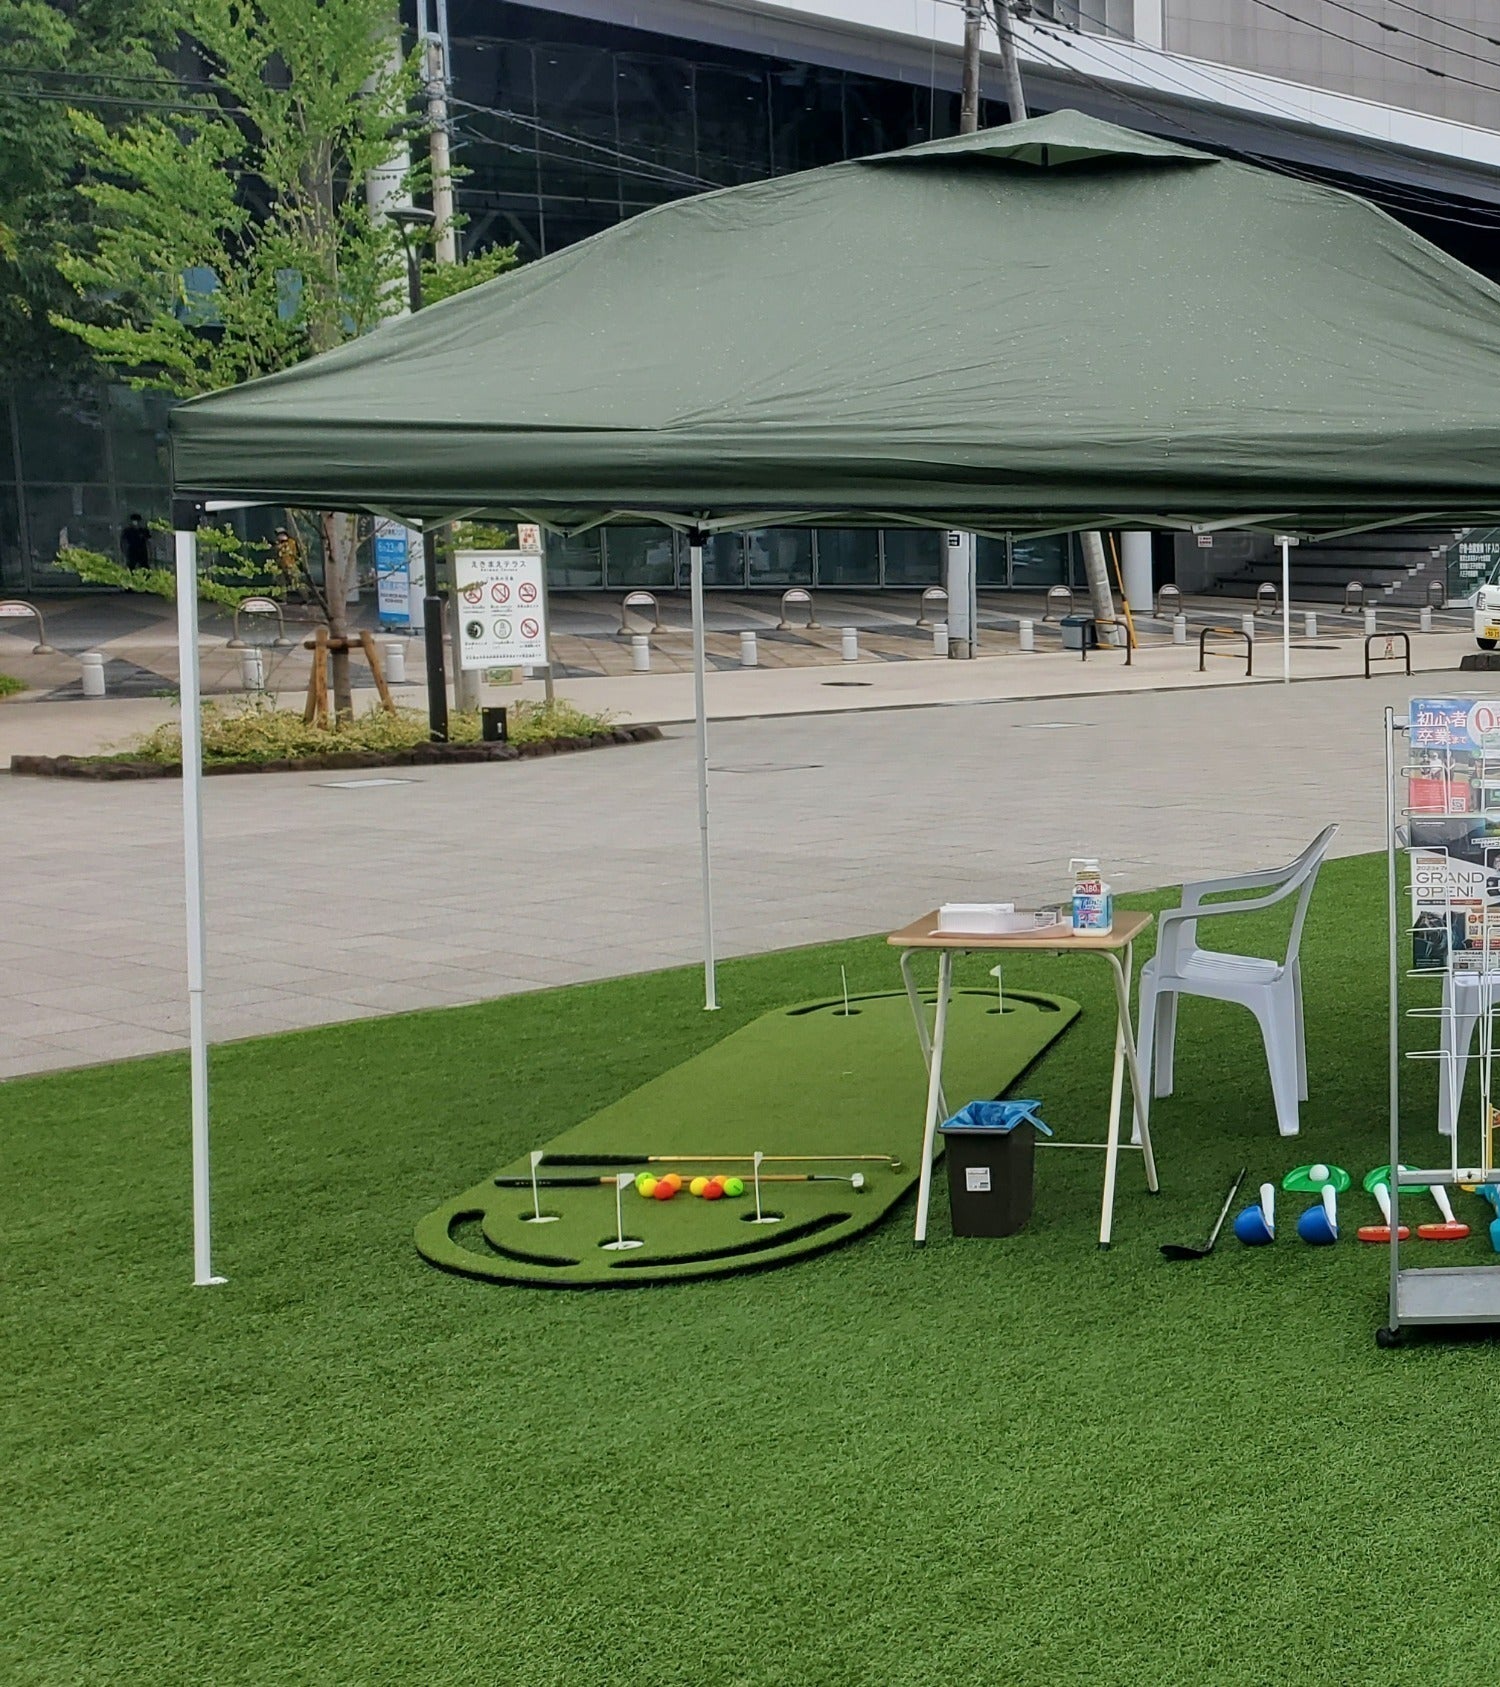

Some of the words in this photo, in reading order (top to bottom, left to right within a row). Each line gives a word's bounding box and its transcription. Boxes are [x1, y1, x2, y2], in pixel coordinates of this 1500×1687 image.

[1417, 711, 1467, 727] 初心者
[1417, 728, 1467, 745] 卒業まで
[1416, 872, 1485, 884] GRAND
[1416, 886, 1473, 897] OPEN!
